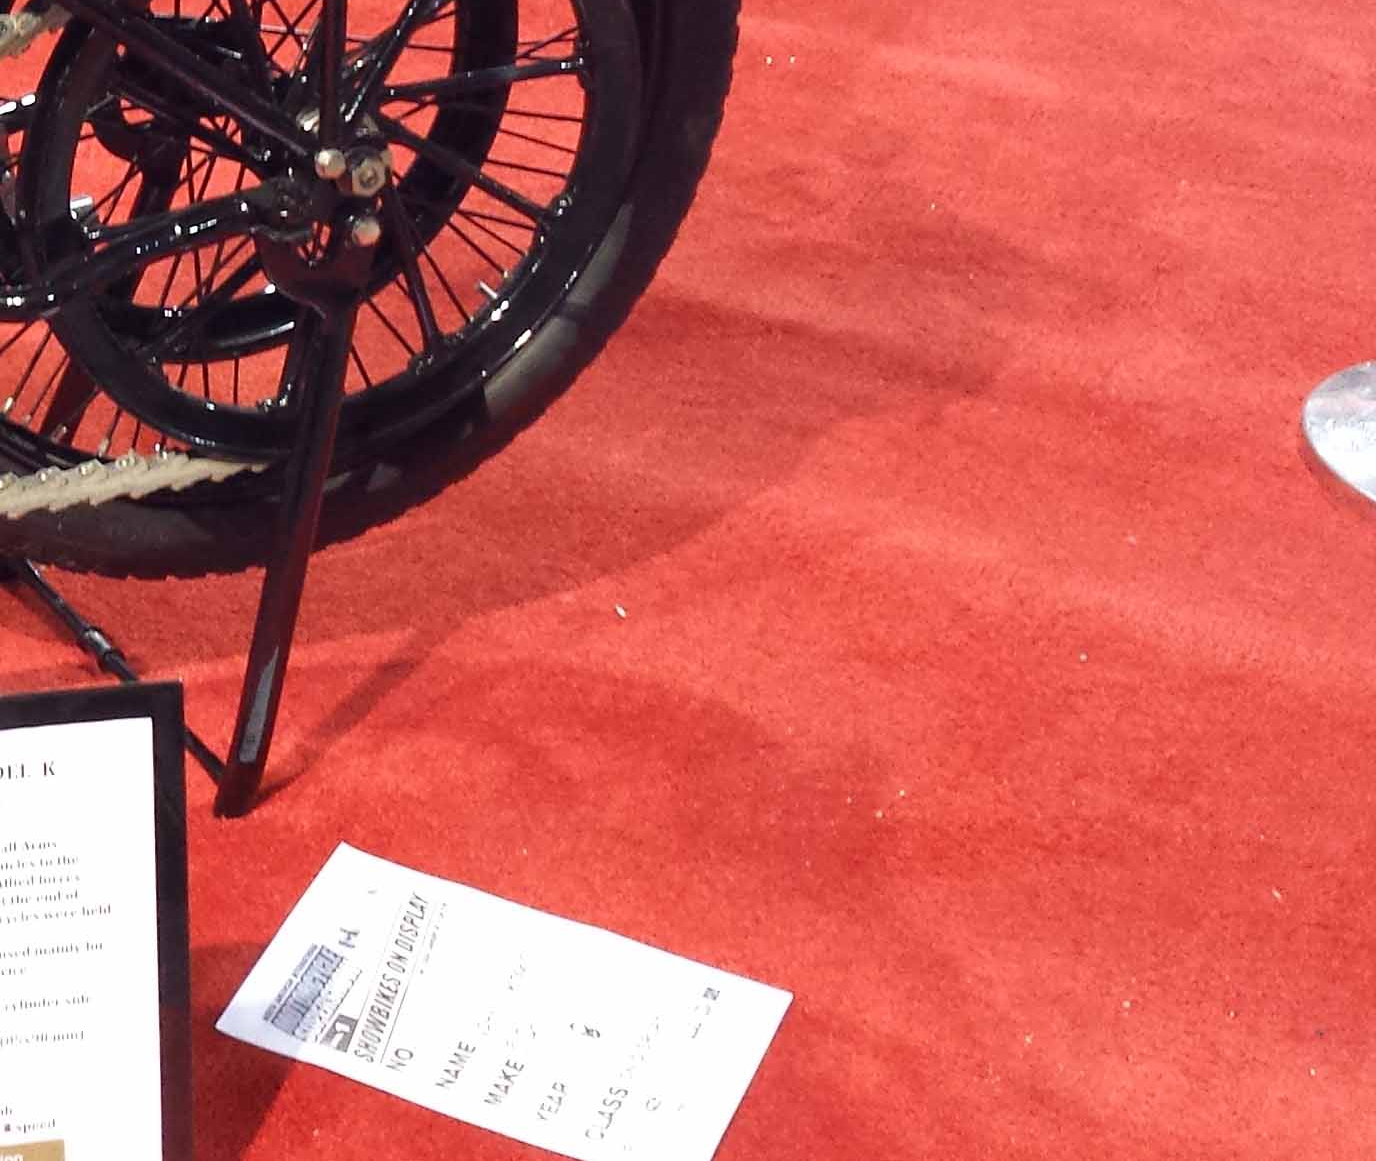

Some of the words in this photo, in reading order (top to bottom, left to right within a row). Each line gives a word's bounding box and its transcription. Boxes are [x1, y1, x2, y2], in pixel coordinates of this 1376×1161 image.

[42, 760, 56, 778] K
[394, 891, 429, 953] DISPLAY
[386, 951, 409, 974] ON
[353, 972, 402, 1064] SHOWBIKES
[385, 1047, 414, 1072] NO
[435, 1040, 476, 1090] NAME
[483, 1058, 525, 1106] MAKE
[536, 1081, 568, 1122] YEAR
[584, 1086, 629, 1140] CLASS
